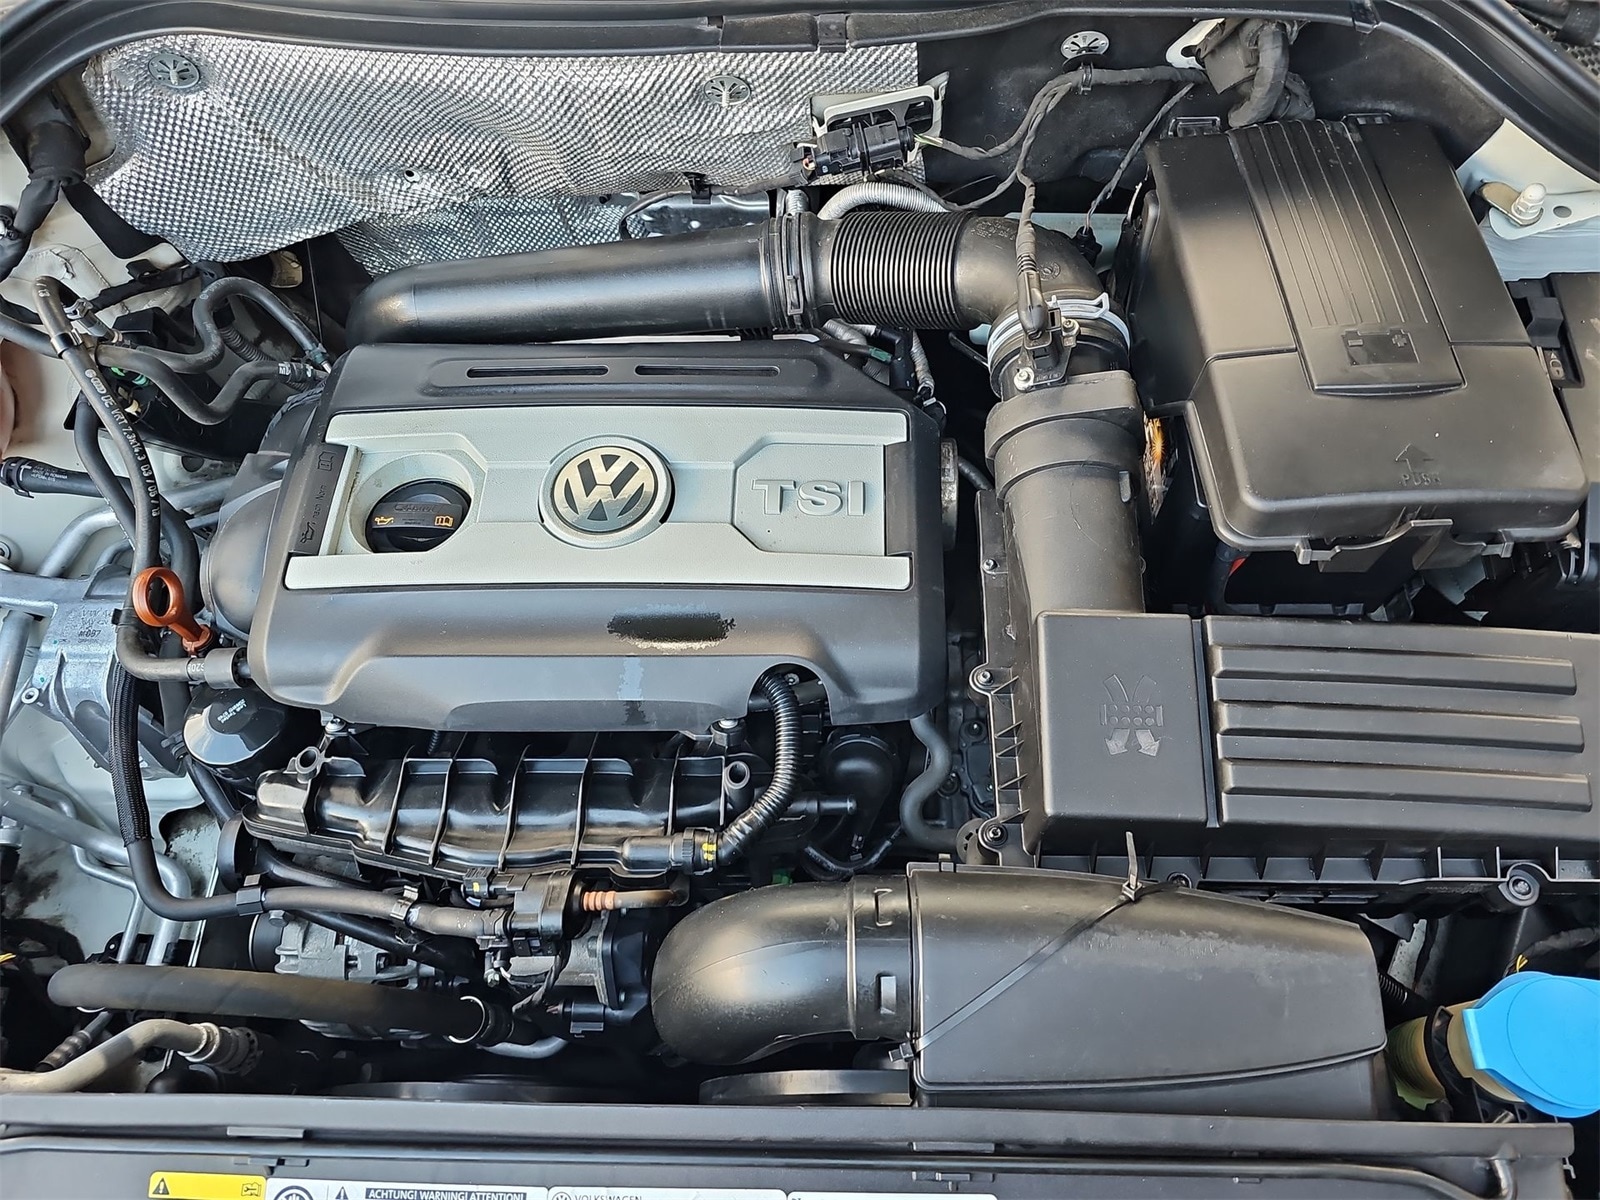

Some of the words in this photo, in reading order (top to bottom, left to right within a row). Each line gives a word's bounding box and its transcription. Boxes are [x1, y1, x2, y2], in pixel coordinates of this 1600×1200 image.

[752, 478, 866, 516] TSI
[369, 1189, 418, 1200] ACHTUNG!
[420, 1191, 468, 1200] WARNING!
[469, 1192, 524, 1200] ATTENTION!
